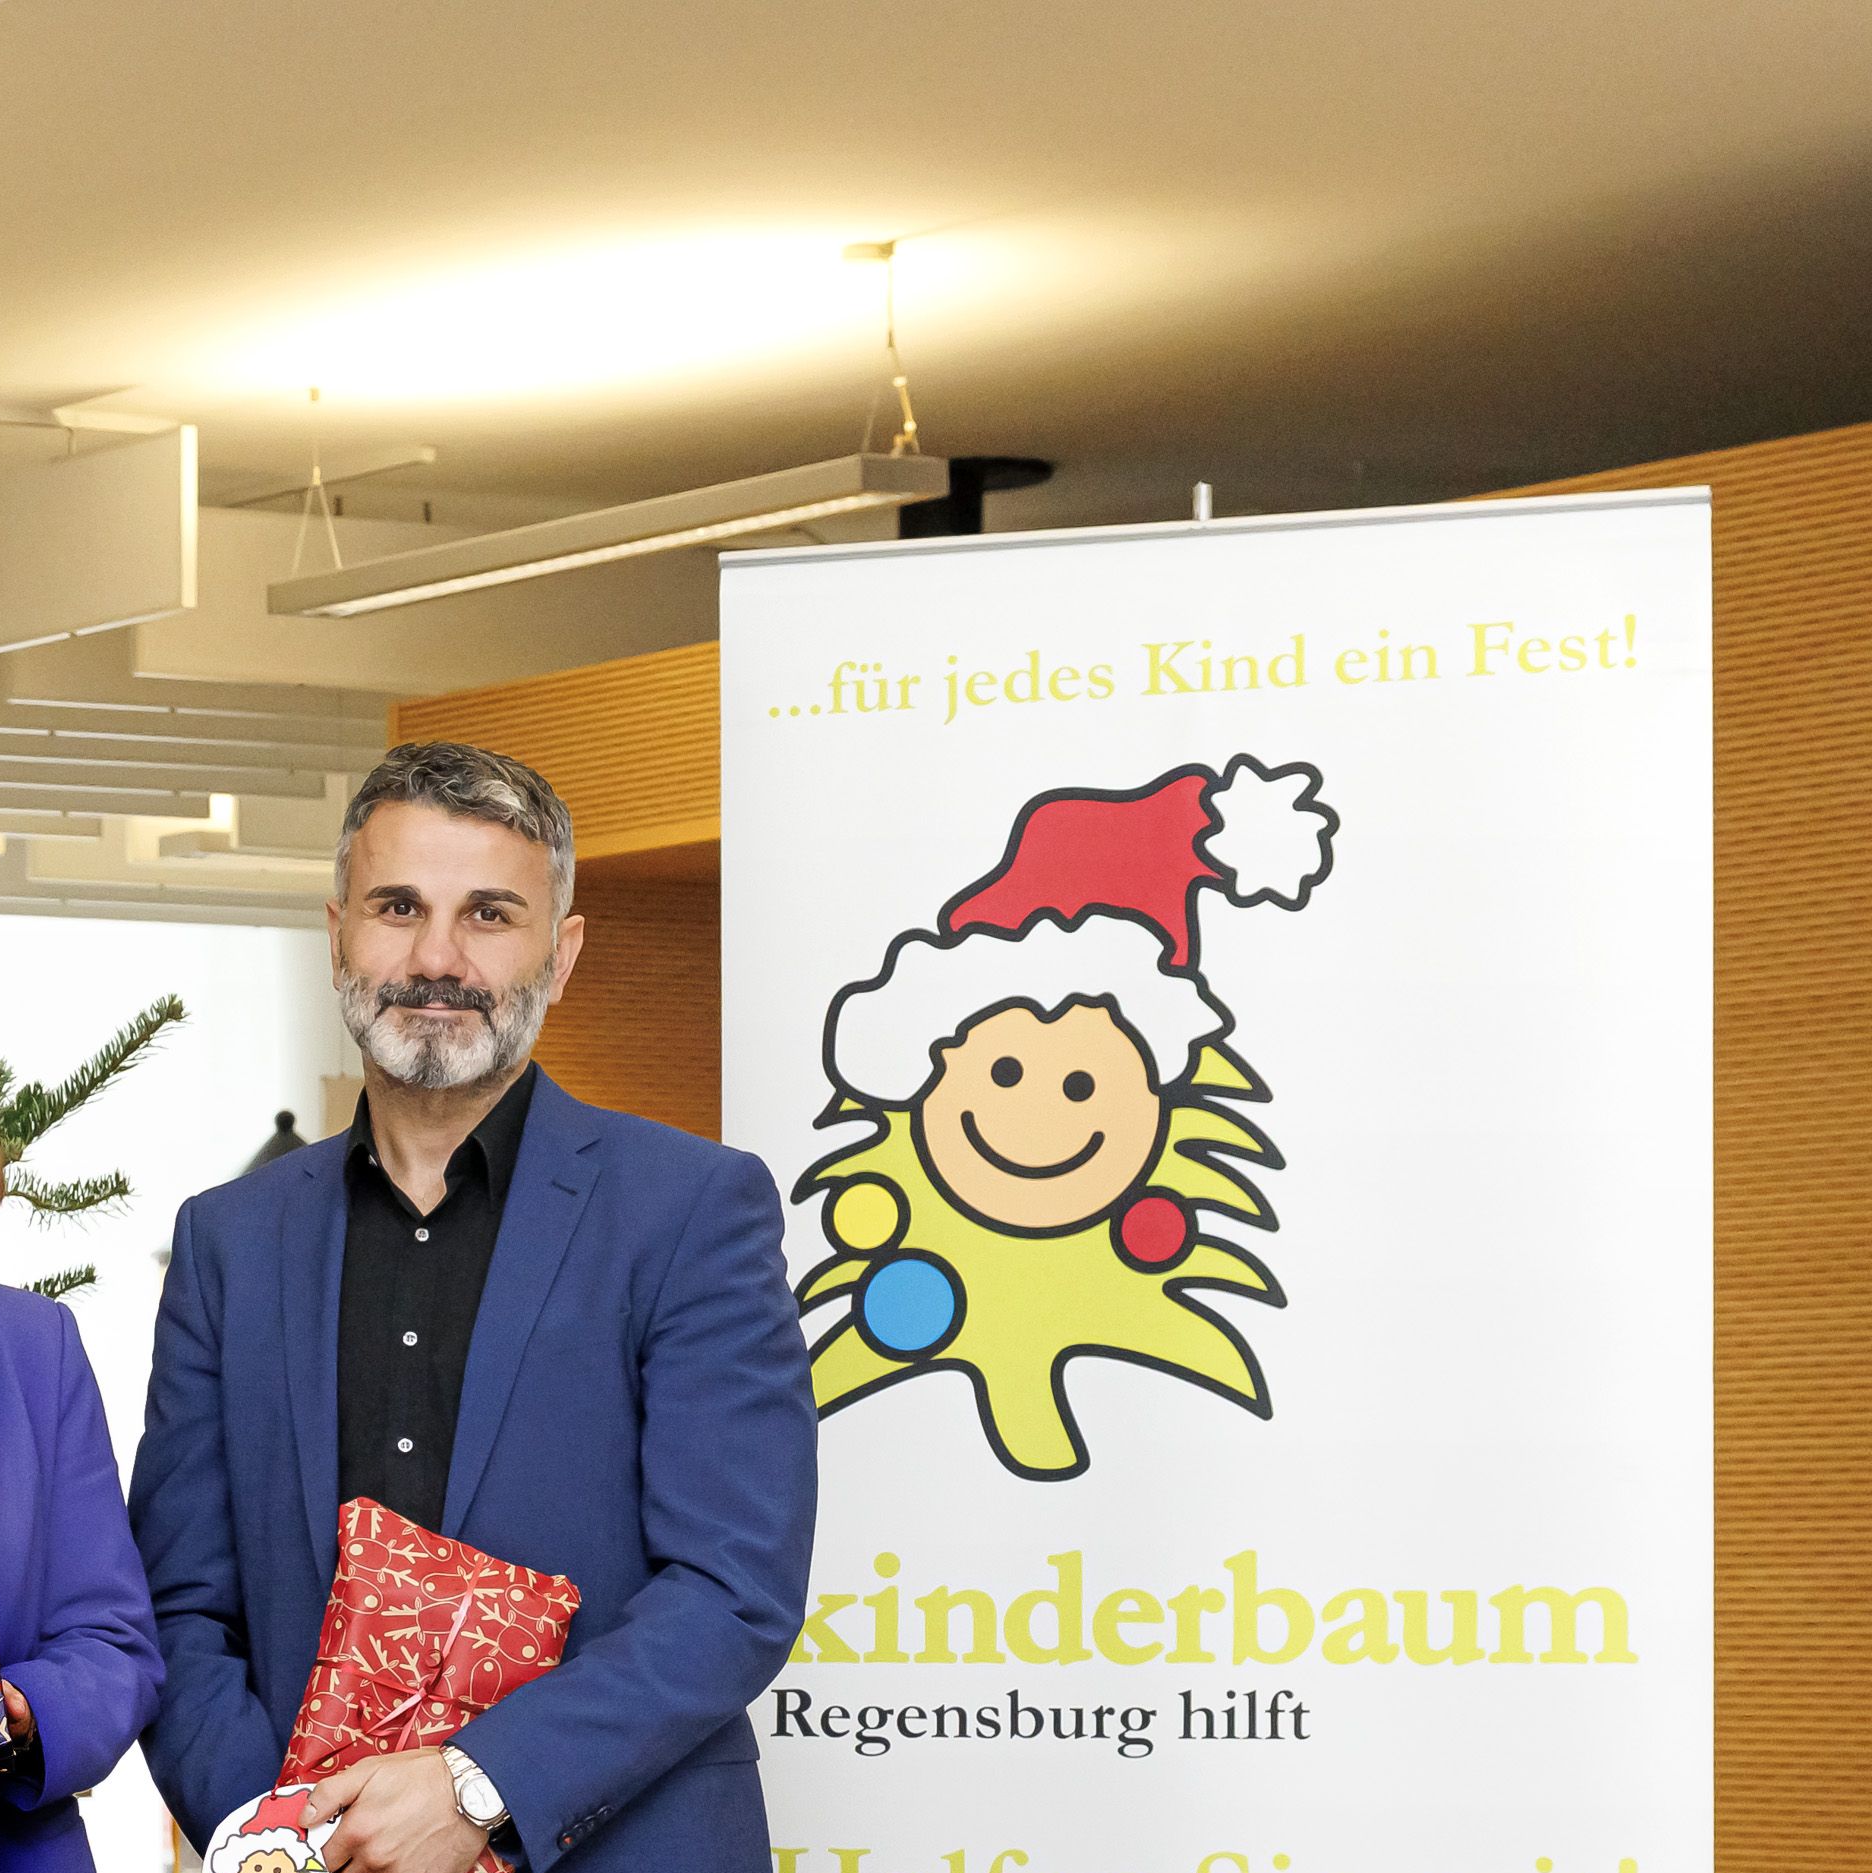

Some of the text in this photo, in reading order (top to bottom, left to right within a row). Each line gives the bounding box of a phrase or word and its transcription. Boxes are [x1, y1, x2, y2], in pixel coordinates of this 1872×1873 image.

[767, 612, 1639, 725] ...für jedes Kind ein Fest!
[769, 1688, 1312, 1759] Regensburg hilft
